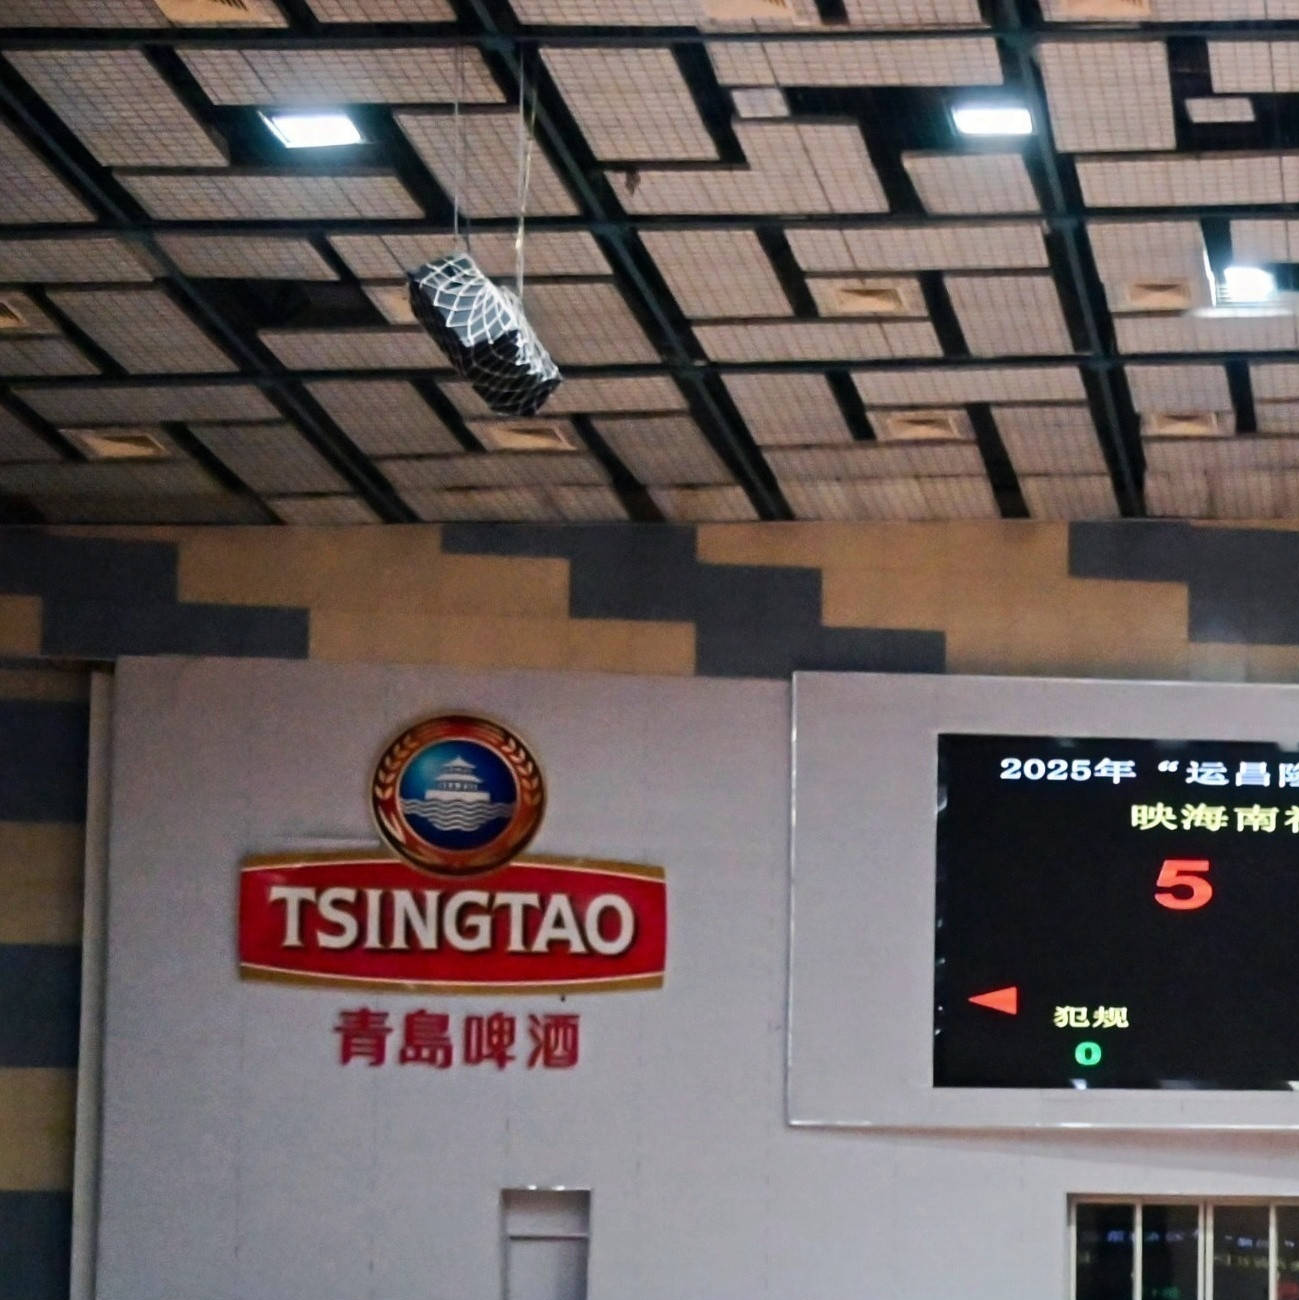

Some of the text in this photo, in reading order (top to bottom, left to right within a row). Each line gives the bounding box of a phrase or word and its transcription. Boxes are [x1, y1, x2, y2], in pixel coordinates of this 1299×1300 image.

[1154, 859, 1213, 910] 5
[269, 886, 635, 956] TSINGTAO
[1053, 1006, 1129, 1028] 犯规
[1074, 1041, 1101, 1066] 0
